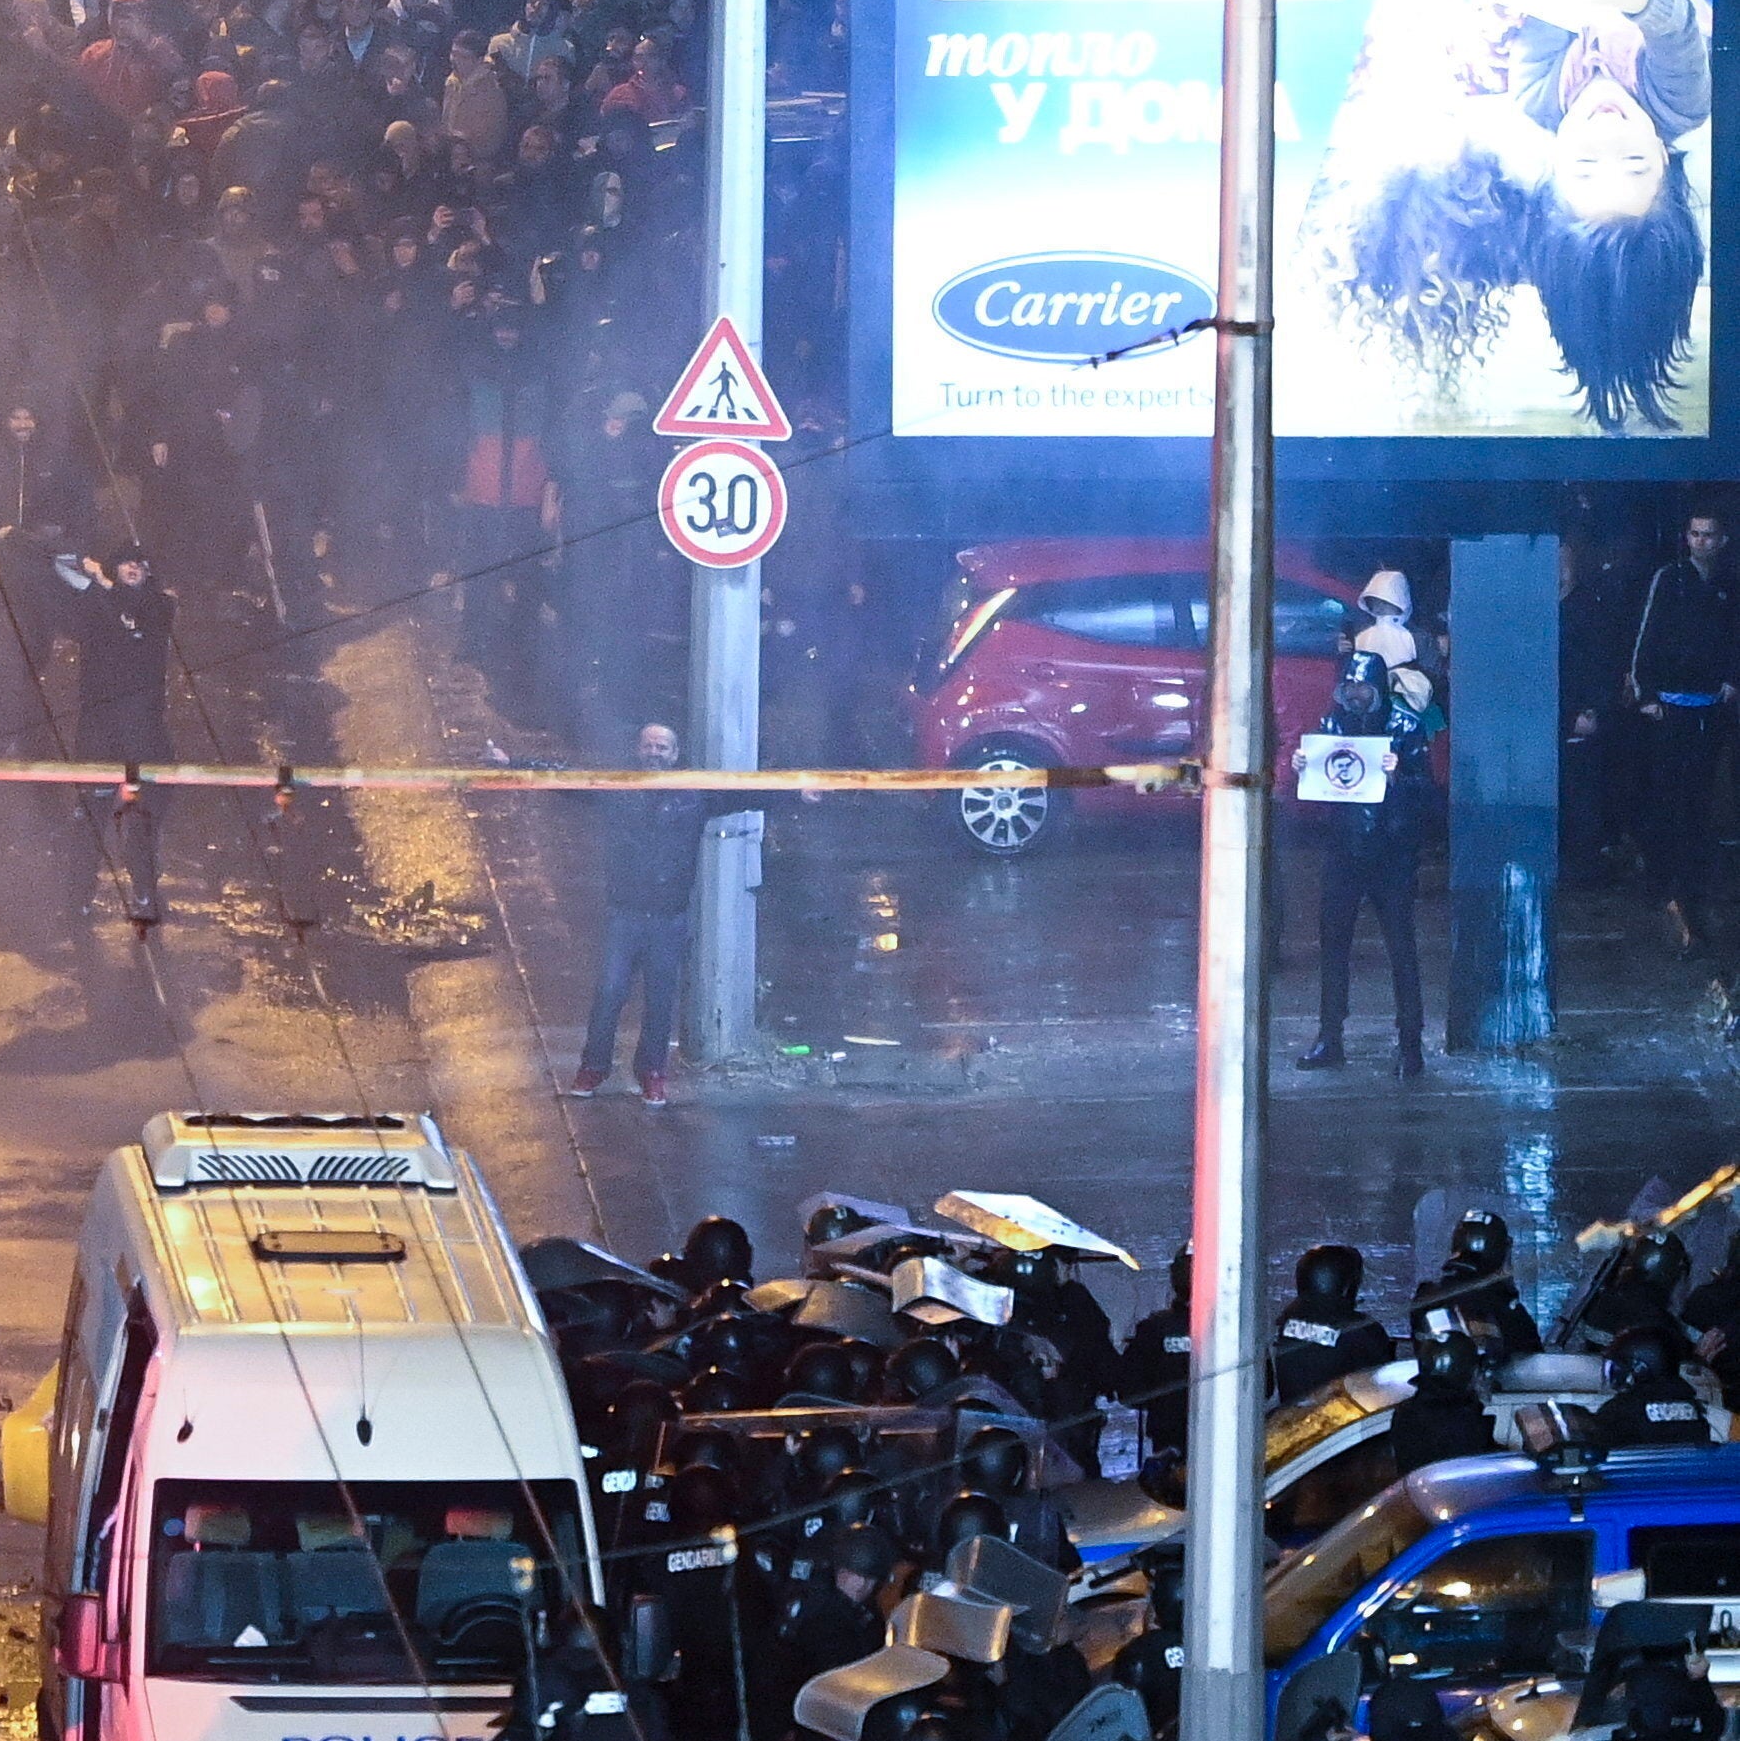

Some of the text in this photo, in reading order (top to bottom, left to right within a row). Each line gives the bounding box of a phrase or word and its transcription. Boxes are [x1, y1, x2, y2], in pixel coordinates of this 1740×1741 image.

[925, 31, 1158, 78] топло
[989, 82, 1048, 143] У
[974, 280, 1183, 328] Carrier
[939, 382, 1214, 412] Turn to the experts
[686, 471, 758, 535] 30
